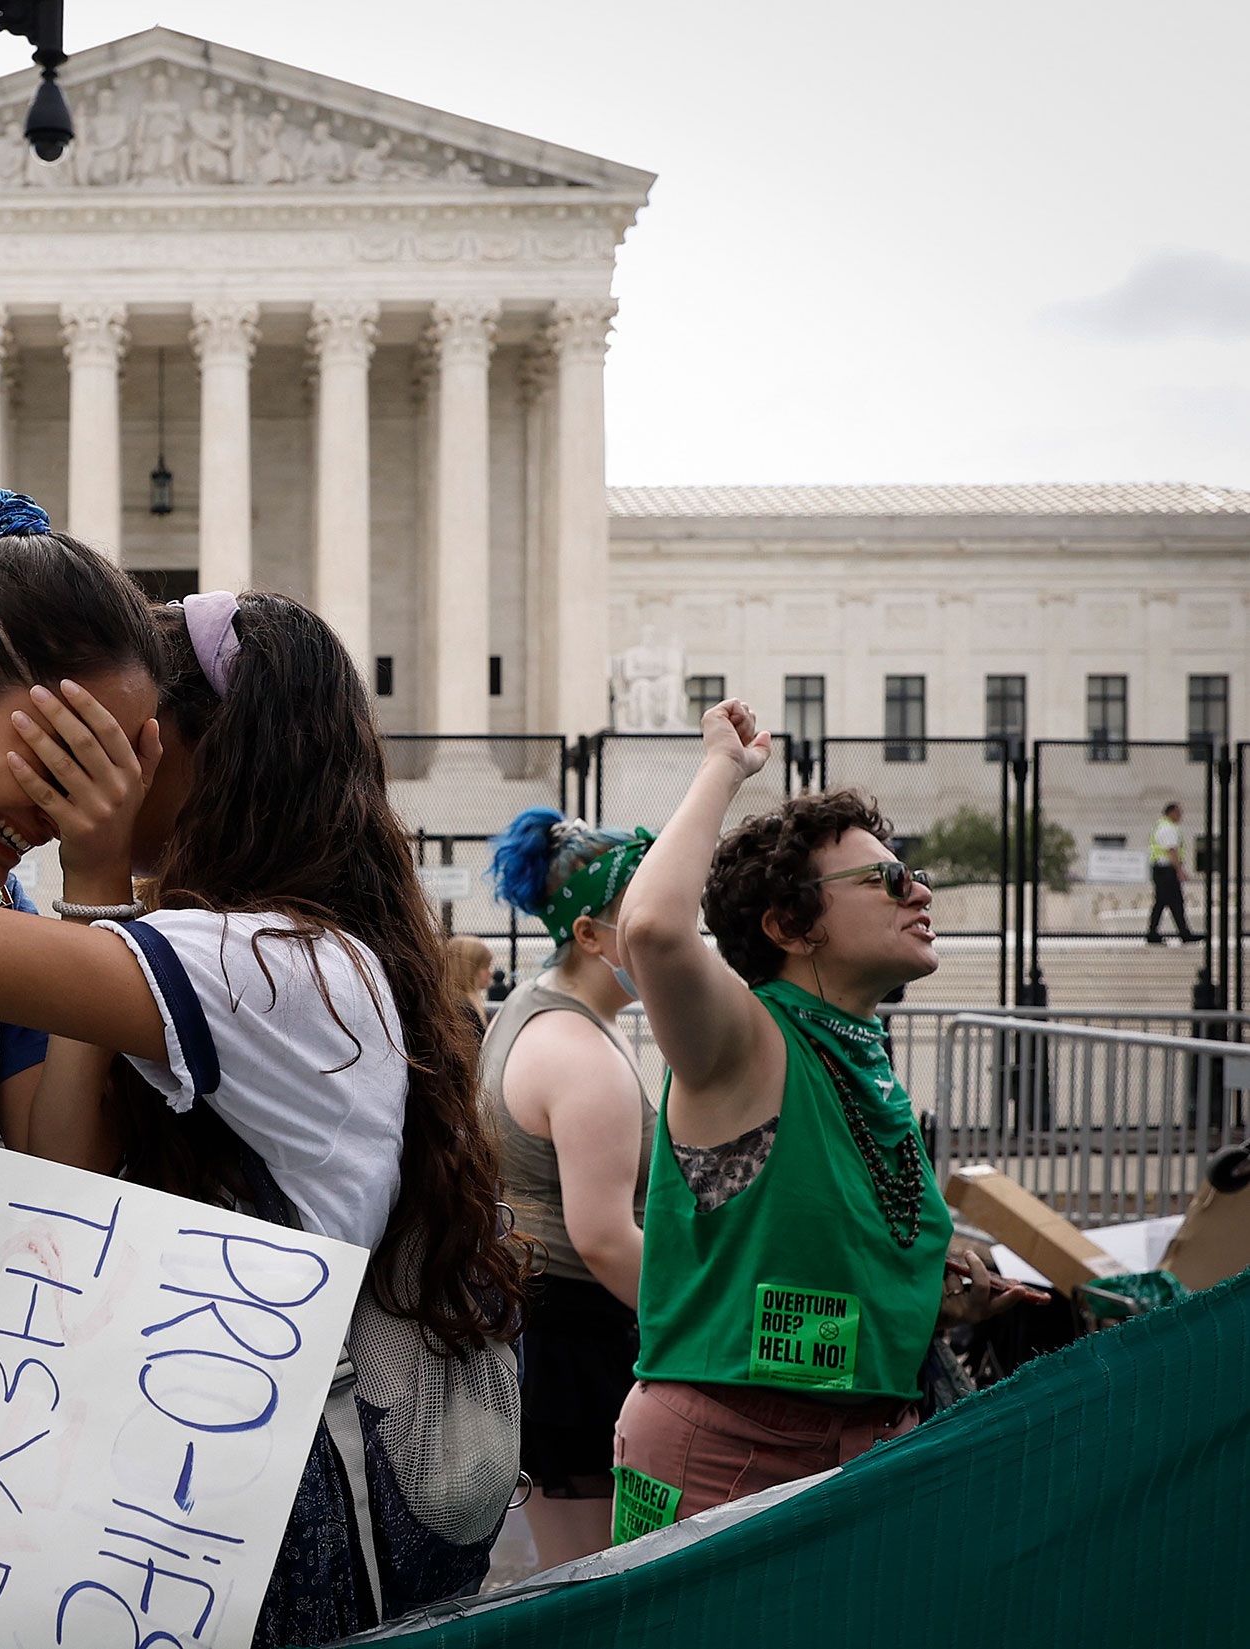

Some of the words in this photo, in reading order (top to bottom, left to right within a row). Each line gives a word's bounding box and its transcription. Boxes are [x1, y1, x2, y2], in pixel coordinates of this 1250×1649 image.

[763, 1289, 848, 1319] OVERTURN
[760, 1311, 805, 1335] ROE?
[757, 1335, 806, 1365] HELL
[812, 1342, 847, 1370] NO!
[620, 1468, 670, 1511] FORCED
